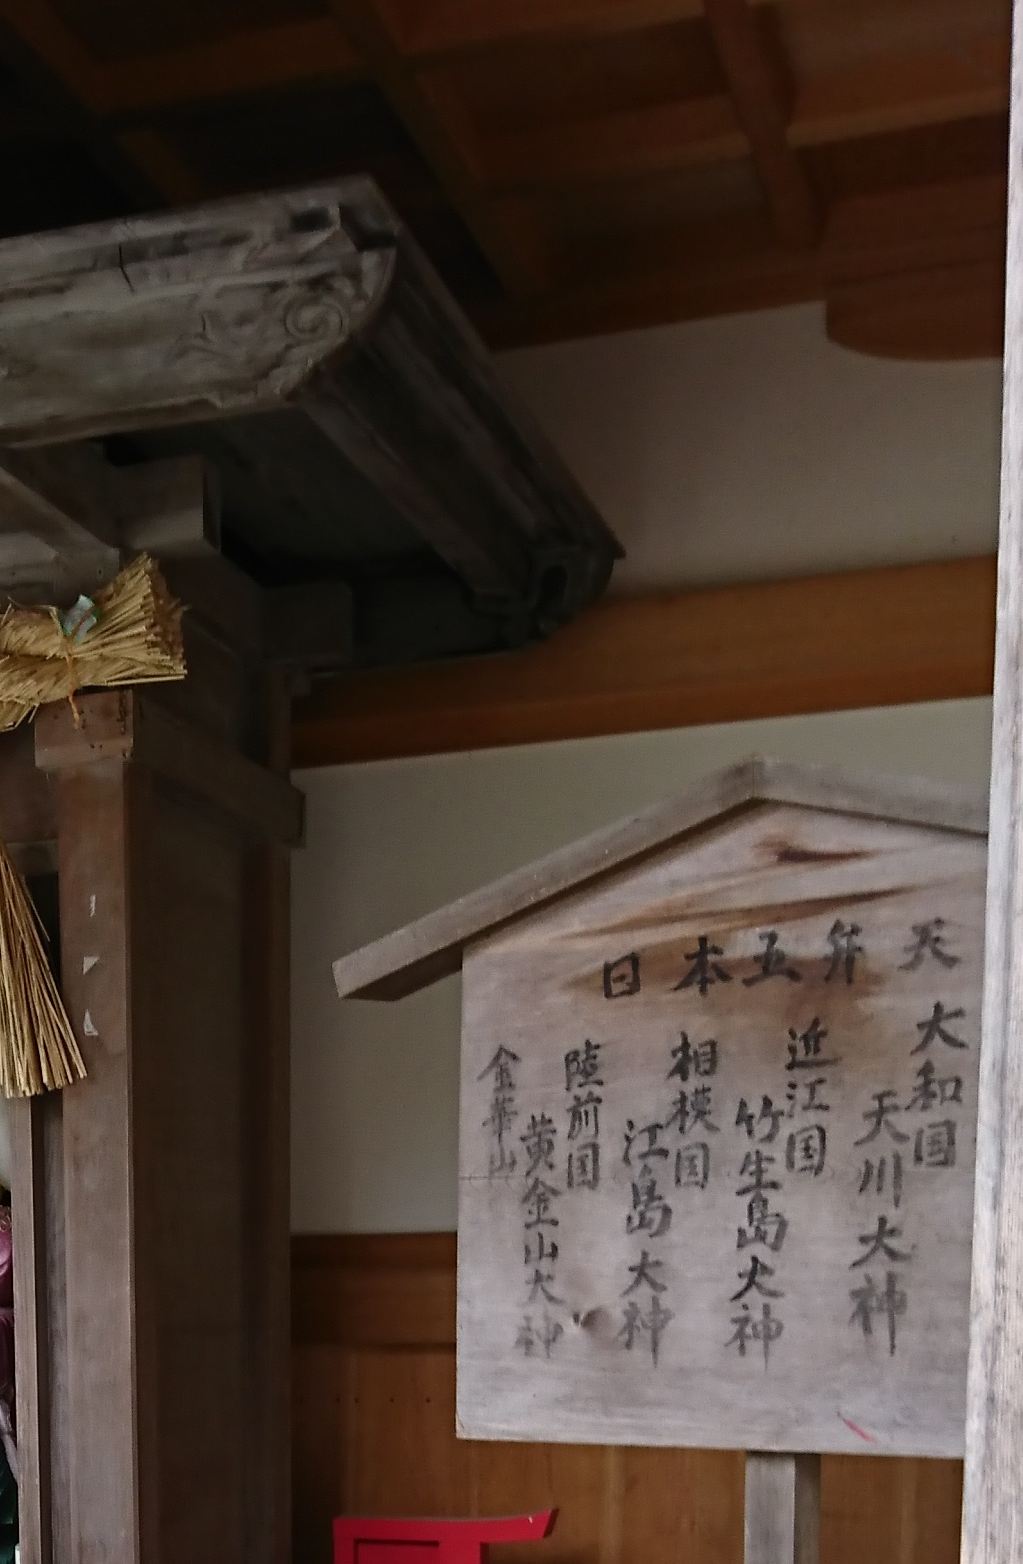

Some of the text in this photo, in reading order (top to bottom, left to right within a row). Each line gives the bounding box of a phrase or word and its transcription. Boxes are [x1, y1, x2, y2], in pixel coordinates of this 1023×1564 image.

[478, 1044, 521, 1177] 金華山
[564, 1039, 606, 1192] 陸前国
[666, 1032, 720, 1190] 相模国
[785, 1018, 841, 1178] 近江国
[911, 1001, 967, 1168] 大和国
[514, 1113, 565, 1360] 黄金山大神
[617, 1119, 675, 1370] 江島大神
[725, 1095, 788, 1372] 竹生島大神
[849, 1092, 914, 1357] 天川大神
